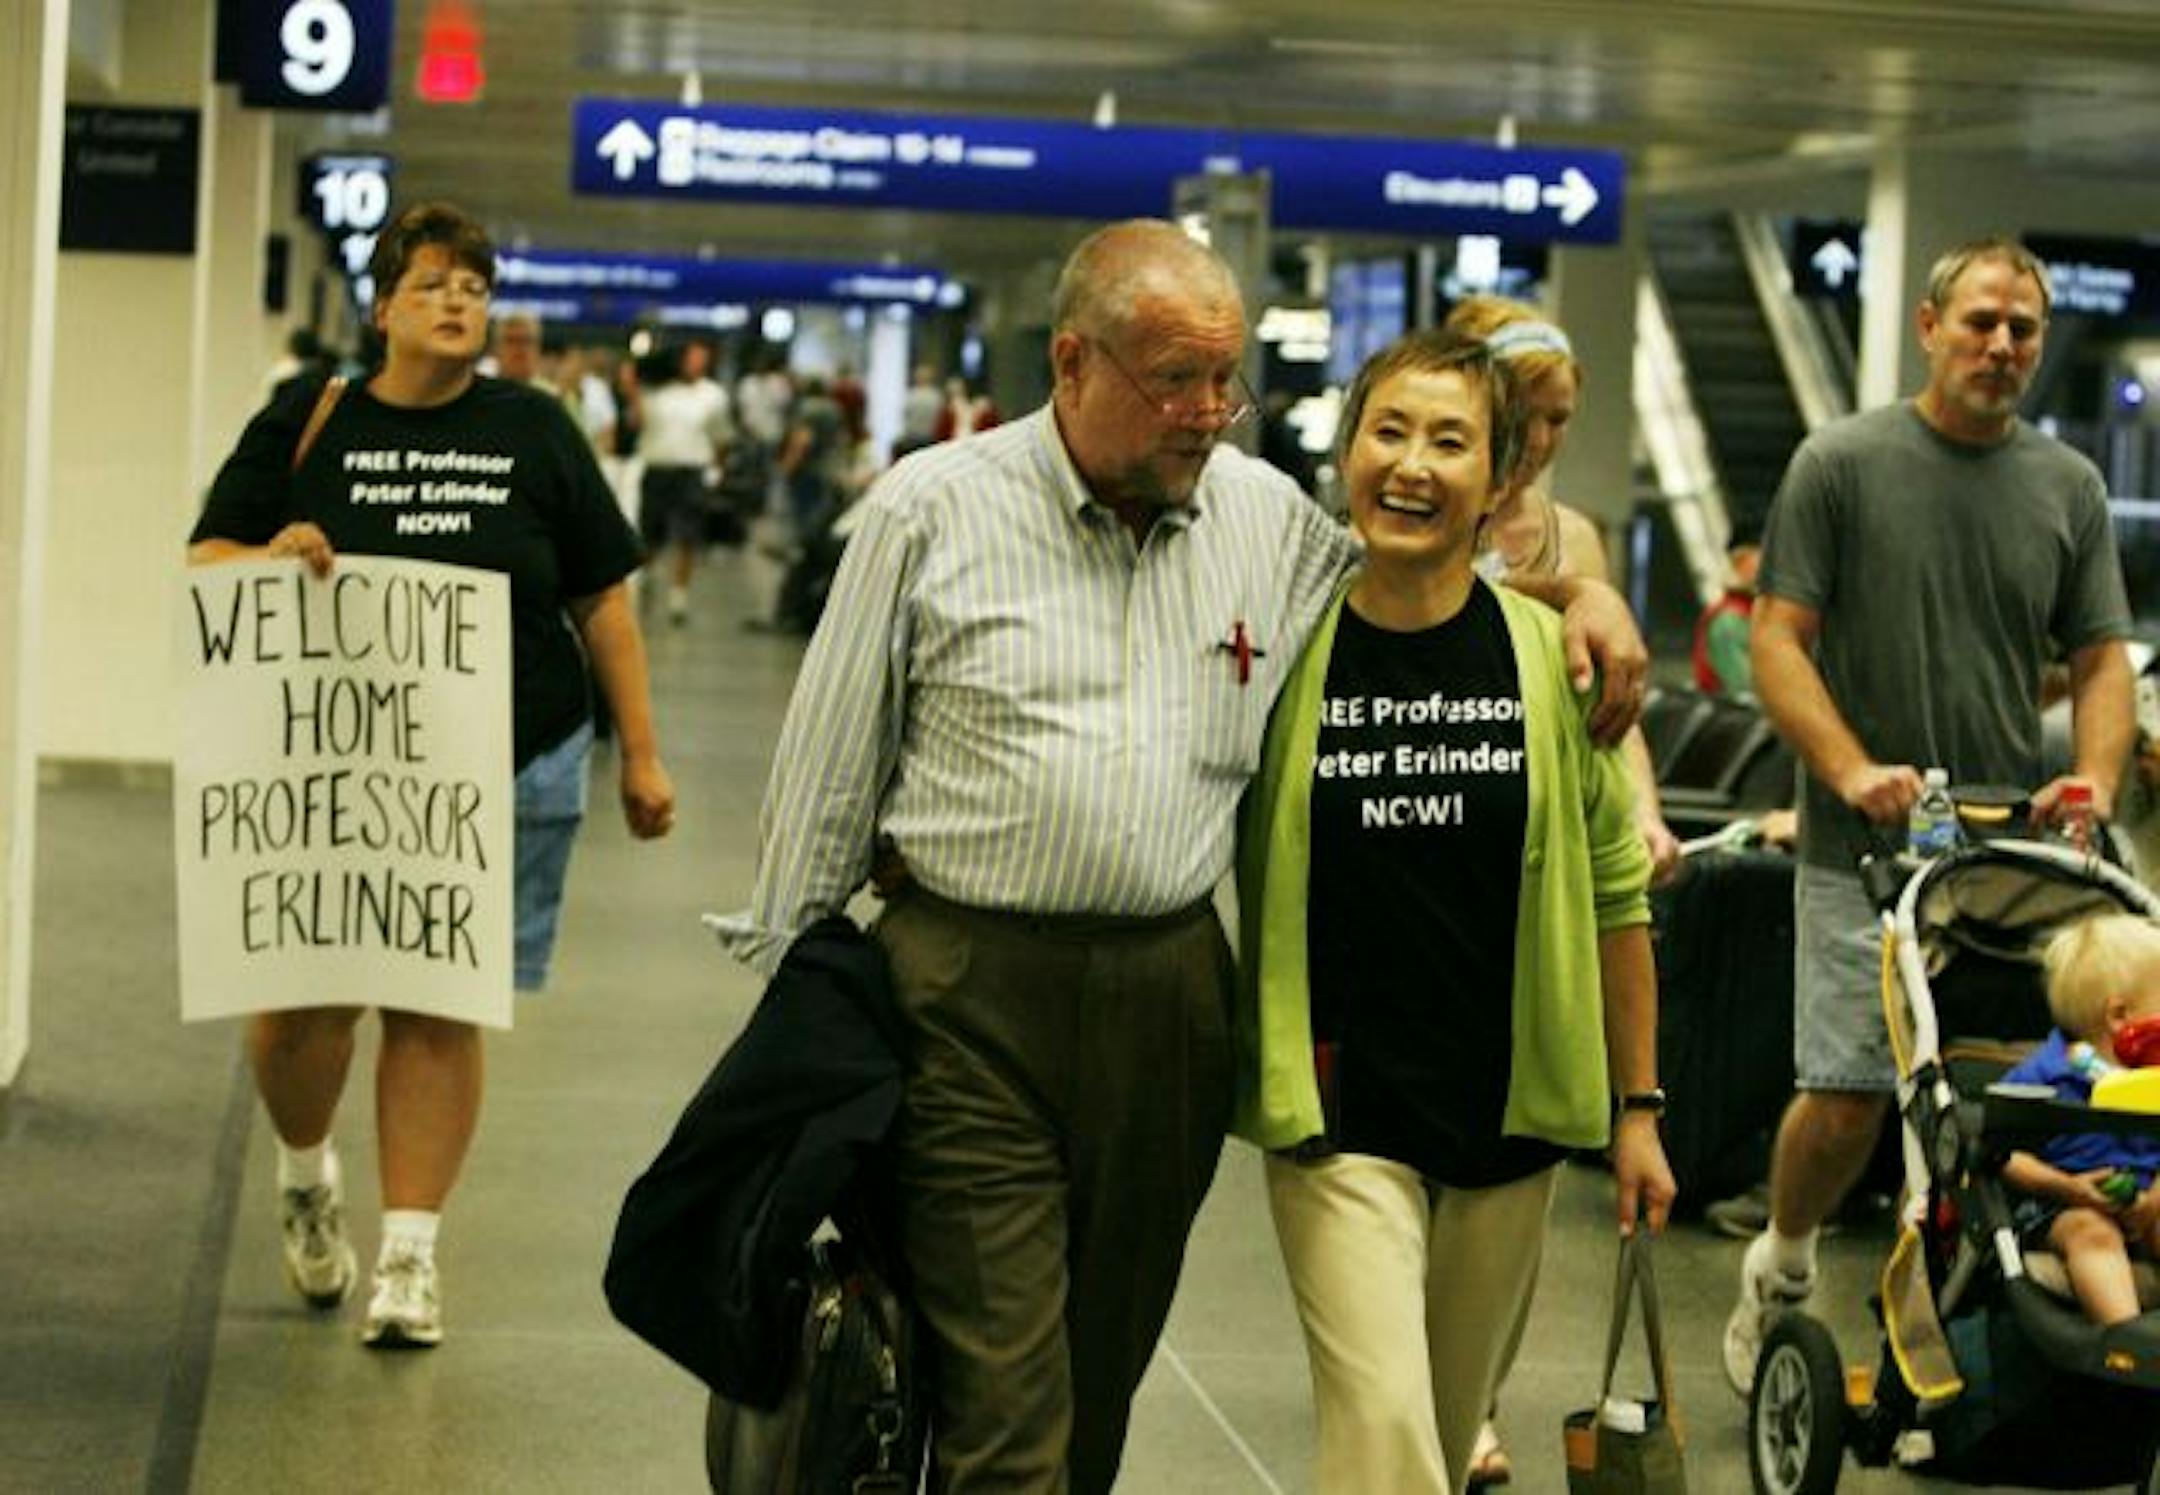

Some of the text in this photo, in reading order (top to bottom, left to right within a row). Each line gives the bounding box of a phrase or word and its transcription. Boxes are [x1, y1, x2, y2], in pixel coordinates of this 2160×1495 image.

[281, 0, 354, 95] 9
[313, 169, 388, 229] 10
[343, 449, 514, 474] FREE Professor
[350, 481, 511, 505] Peter Erlinder
[191, 572, 477, 675] WELCOME
[282, 677, 426, 762] HOME
[1312, 750, 1386, 778] eter
[202, 770, 486, 871] PROFESSOR
[242, 867, 477, 969] ERLINDER
